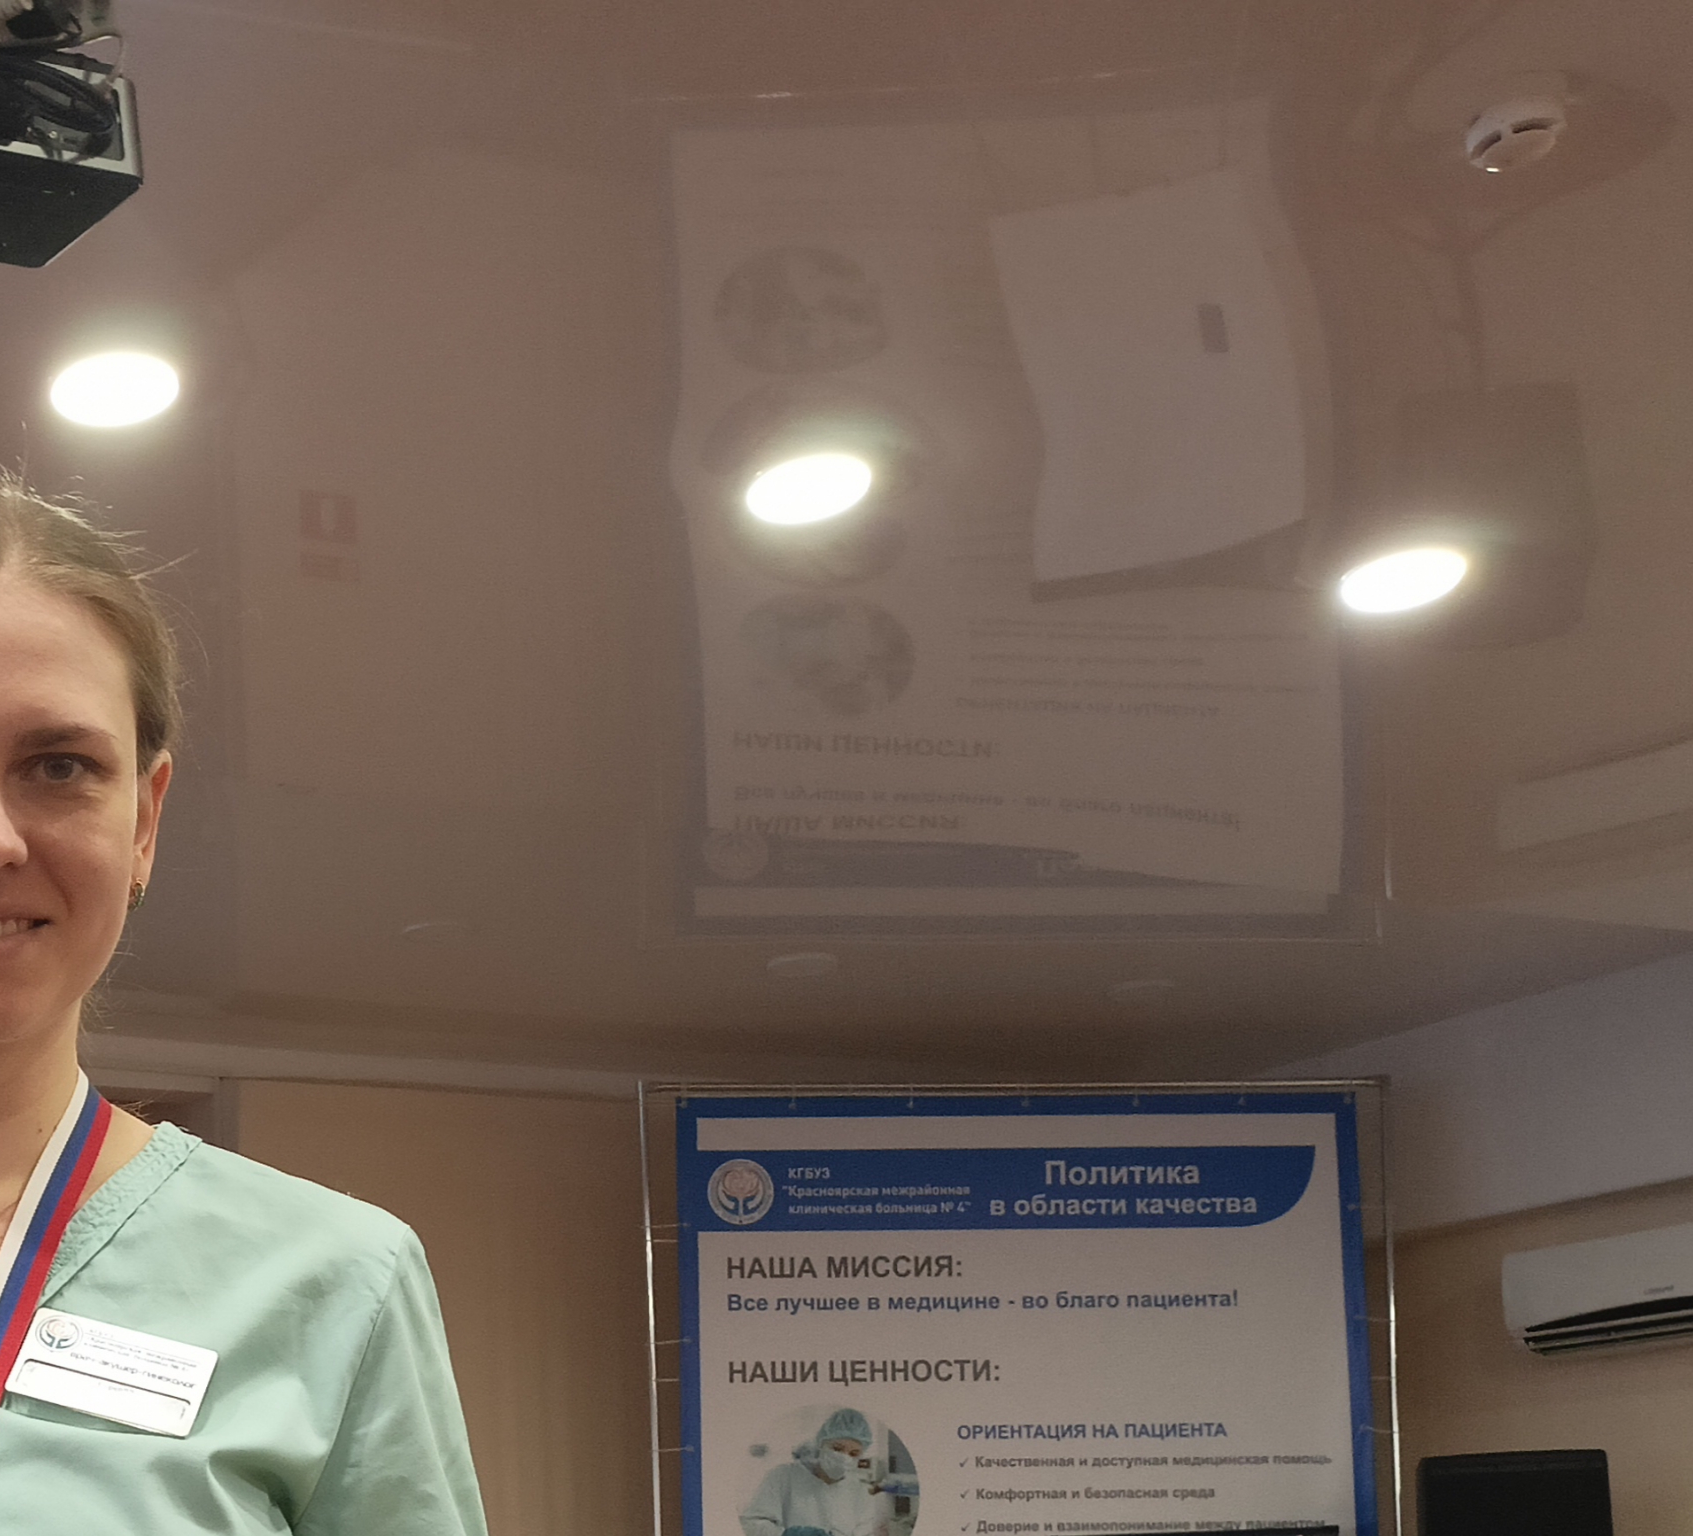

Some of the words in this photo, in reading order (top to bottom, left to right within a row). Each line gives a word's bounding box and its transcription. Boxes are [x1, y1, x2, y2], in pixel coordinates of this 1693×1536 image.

[788, 1167, 831, 1180] КГБУЗ
[1044, 1159, 1201, 1187] Политика
[881, 1184, 971, 1198] межрайонная
[788, 1202, 874, 1216] клиническая
[875, 1202, 938, 1217] больница
[989, 1200, 1006, 1216] в
[1013, 1193, 1128, 1216] области
[1135, 1196, 1258, 1215] качества
[726, 1256, 818, 1280] НАША
[826, 1254, 963, 1279] МИССИЯ:
[727, 1294, 769, 1312] Все
[774, 1297, 860, 1316] лучшее
[867, 1297, 881, 1311] в
[887, 1296, 1000, 1313] медицине
[1021, 1295, 1049, 1310] во
[1055, 1291, 1120, 1310] благо
[1126, 1289, 1239, 1310] пациента!
[728, 1360, 819, 1384] НАШИ
[827, 1358, 1001, 1387] ЦЕННОСТИ:
[957, 1424, 1087, 1442] ОРИЕНТАЦИЯ
[1092, 1423, 1120, 1439] НА
[1124, 1422, 1228, 1440] ПАЦИЕНТА
[975, 1455, 1075, 1469] Качественная
[1079, 1457, 1088, 1467] и
[1091, 1456, 1168, 1470] доступная
[1172, 1455, 1270, 1468] медицинская
[975, 1488, 1067, 1503] Комфортная
[1071, 1489, 1080, 1499] и
[1084, 1487, 1169, 1500] безопасная
[1172, 1487, 1216, 1501] среда
[976, 1520, 1040, 1534] Доверие
[1043, 1521, 1053, 1532] и
[1056, 1519, 1192, 1533] взаимопонимание
